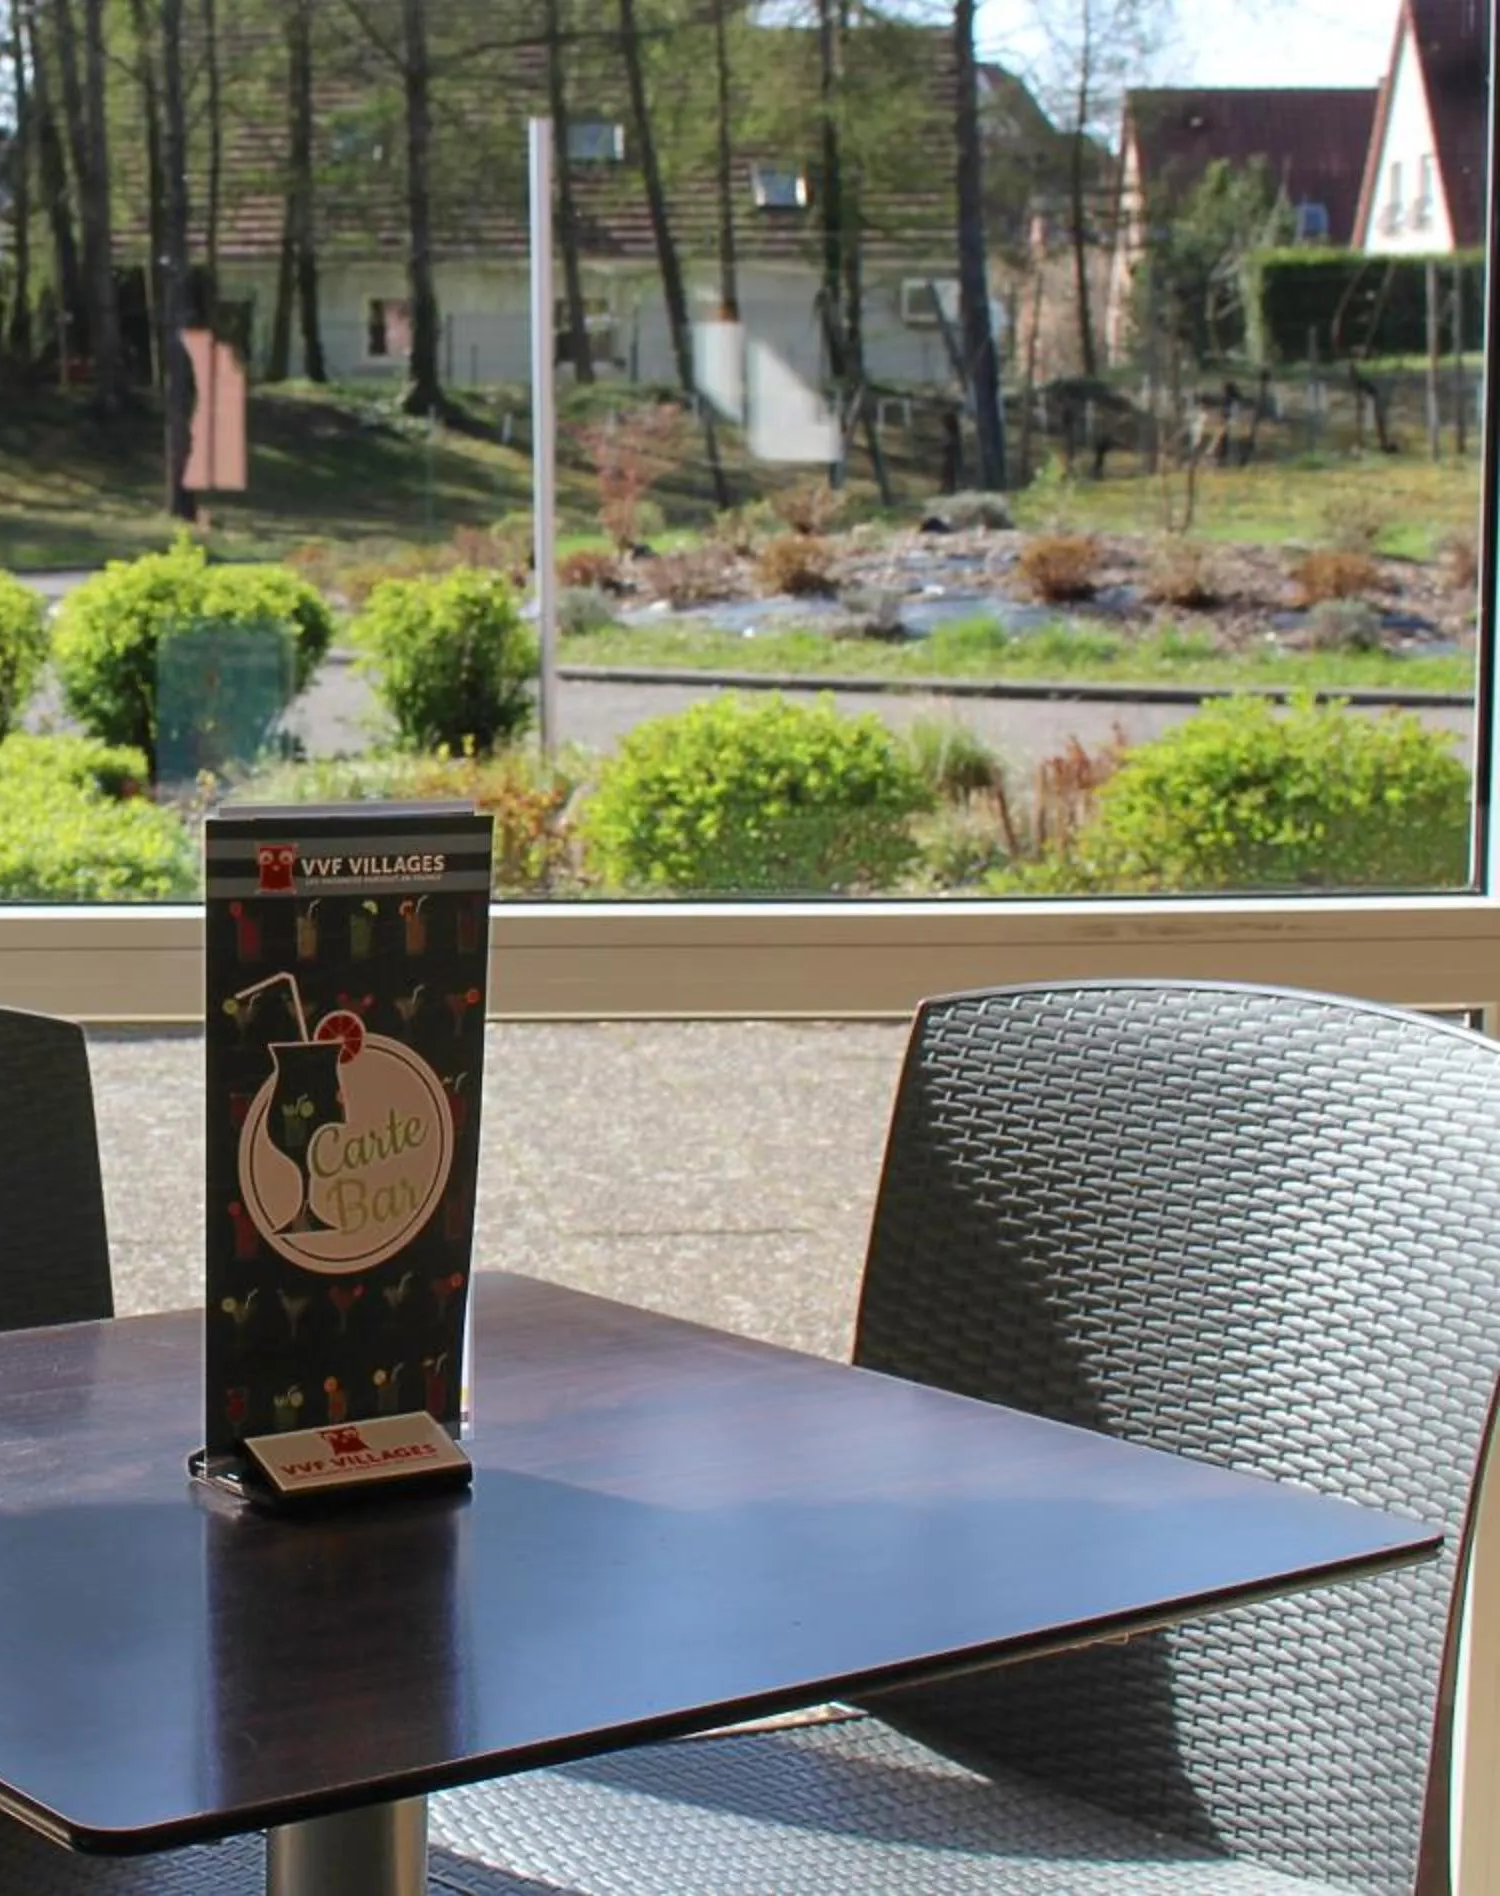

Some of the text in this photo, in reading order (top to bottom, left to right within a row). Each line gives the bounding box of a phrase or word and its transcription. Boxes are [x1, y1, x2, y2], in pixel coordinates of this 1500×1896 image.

[300, 854, 445, 876] VVF VILLAGES
[311, 1108, 427, 1177] Carte
[326, 1177, 419, 1236] Bar
[280, 1460, 326, 1476] VVF
[332, 1443, 437, 1467] VILLAGES
